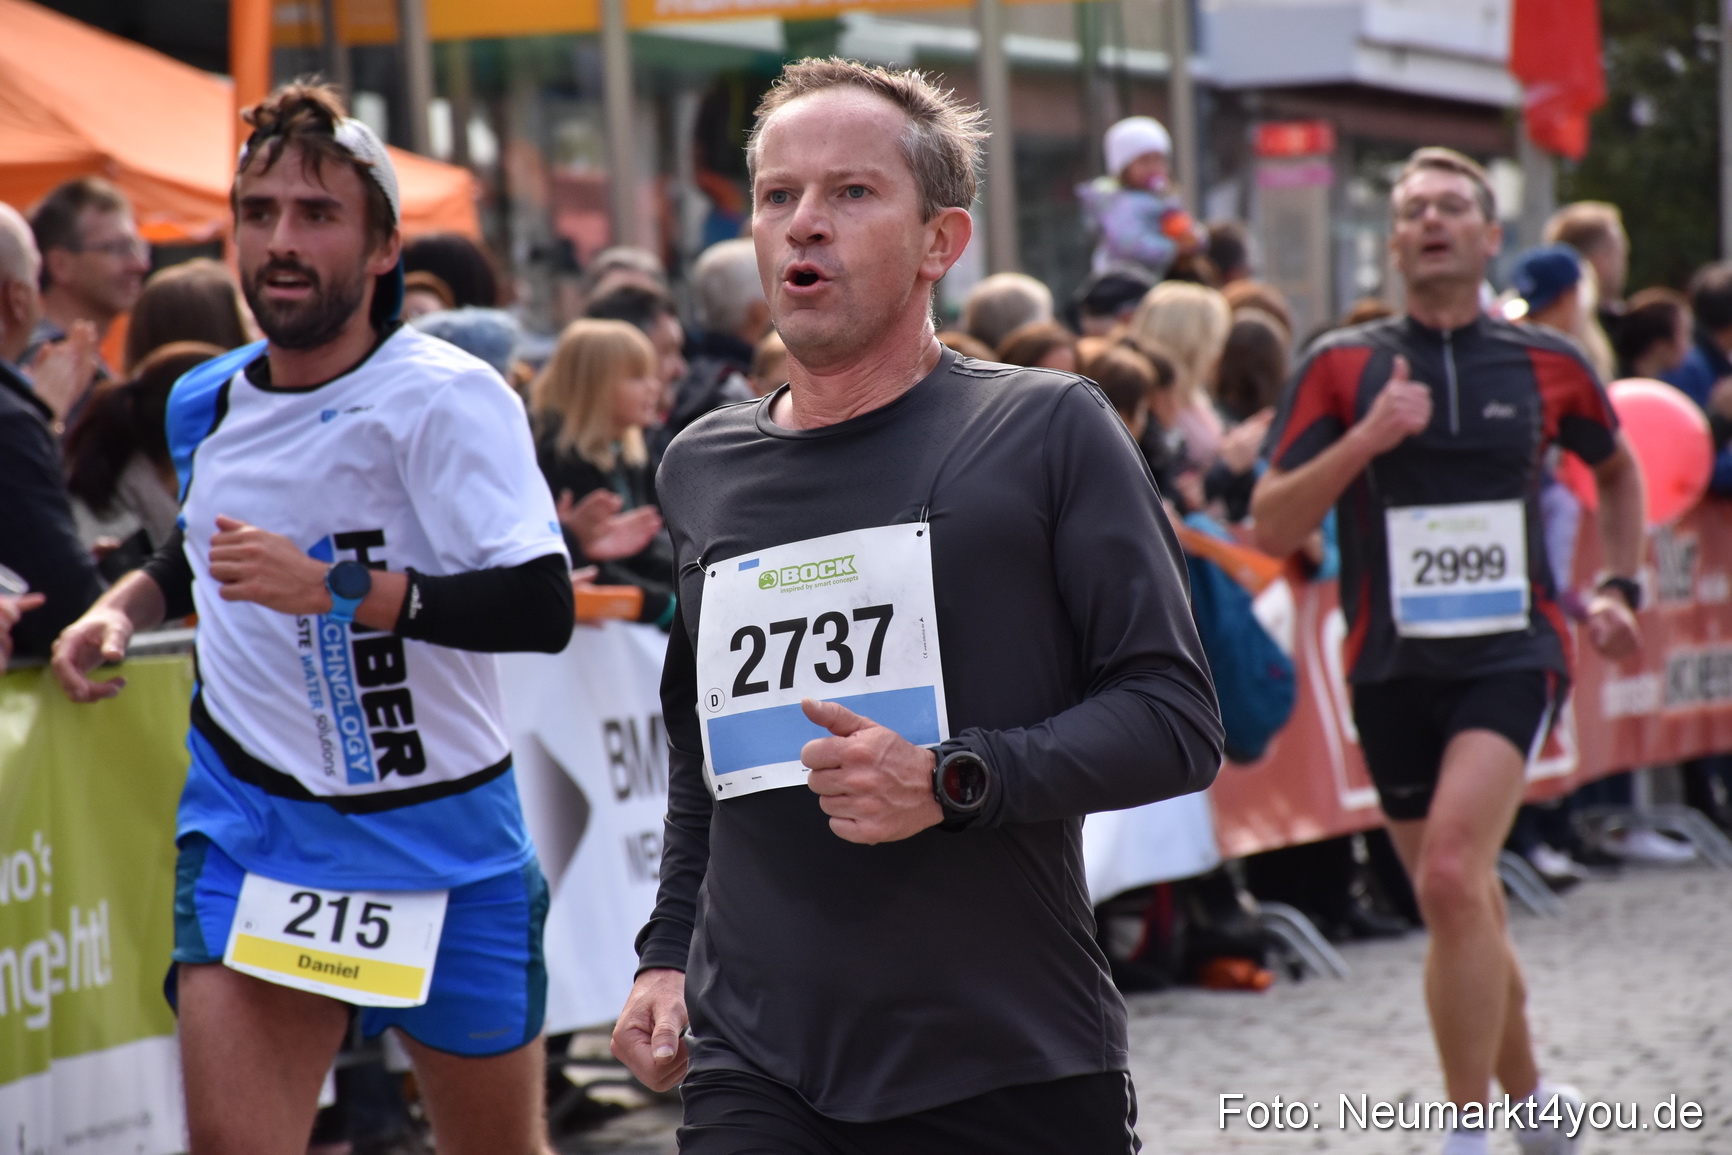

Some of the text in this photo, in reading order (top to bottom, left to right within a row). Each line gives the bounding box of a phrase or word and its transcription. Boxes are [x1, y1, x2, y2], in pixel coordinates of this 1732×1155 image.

[780, 555, 857, 586] BOCK
[1412, 543, 1506, 586] 2999
[780, 584, 804, 594] inspired
[814, 580, 832, 589] smart
[832, 575, 859, 586] concepts
[730, 603, 894, 698] 2737
[711, 694, 719, 707] D
[283, 891, 393, 950] 215
[297, 954, 361, 980] Daniel
